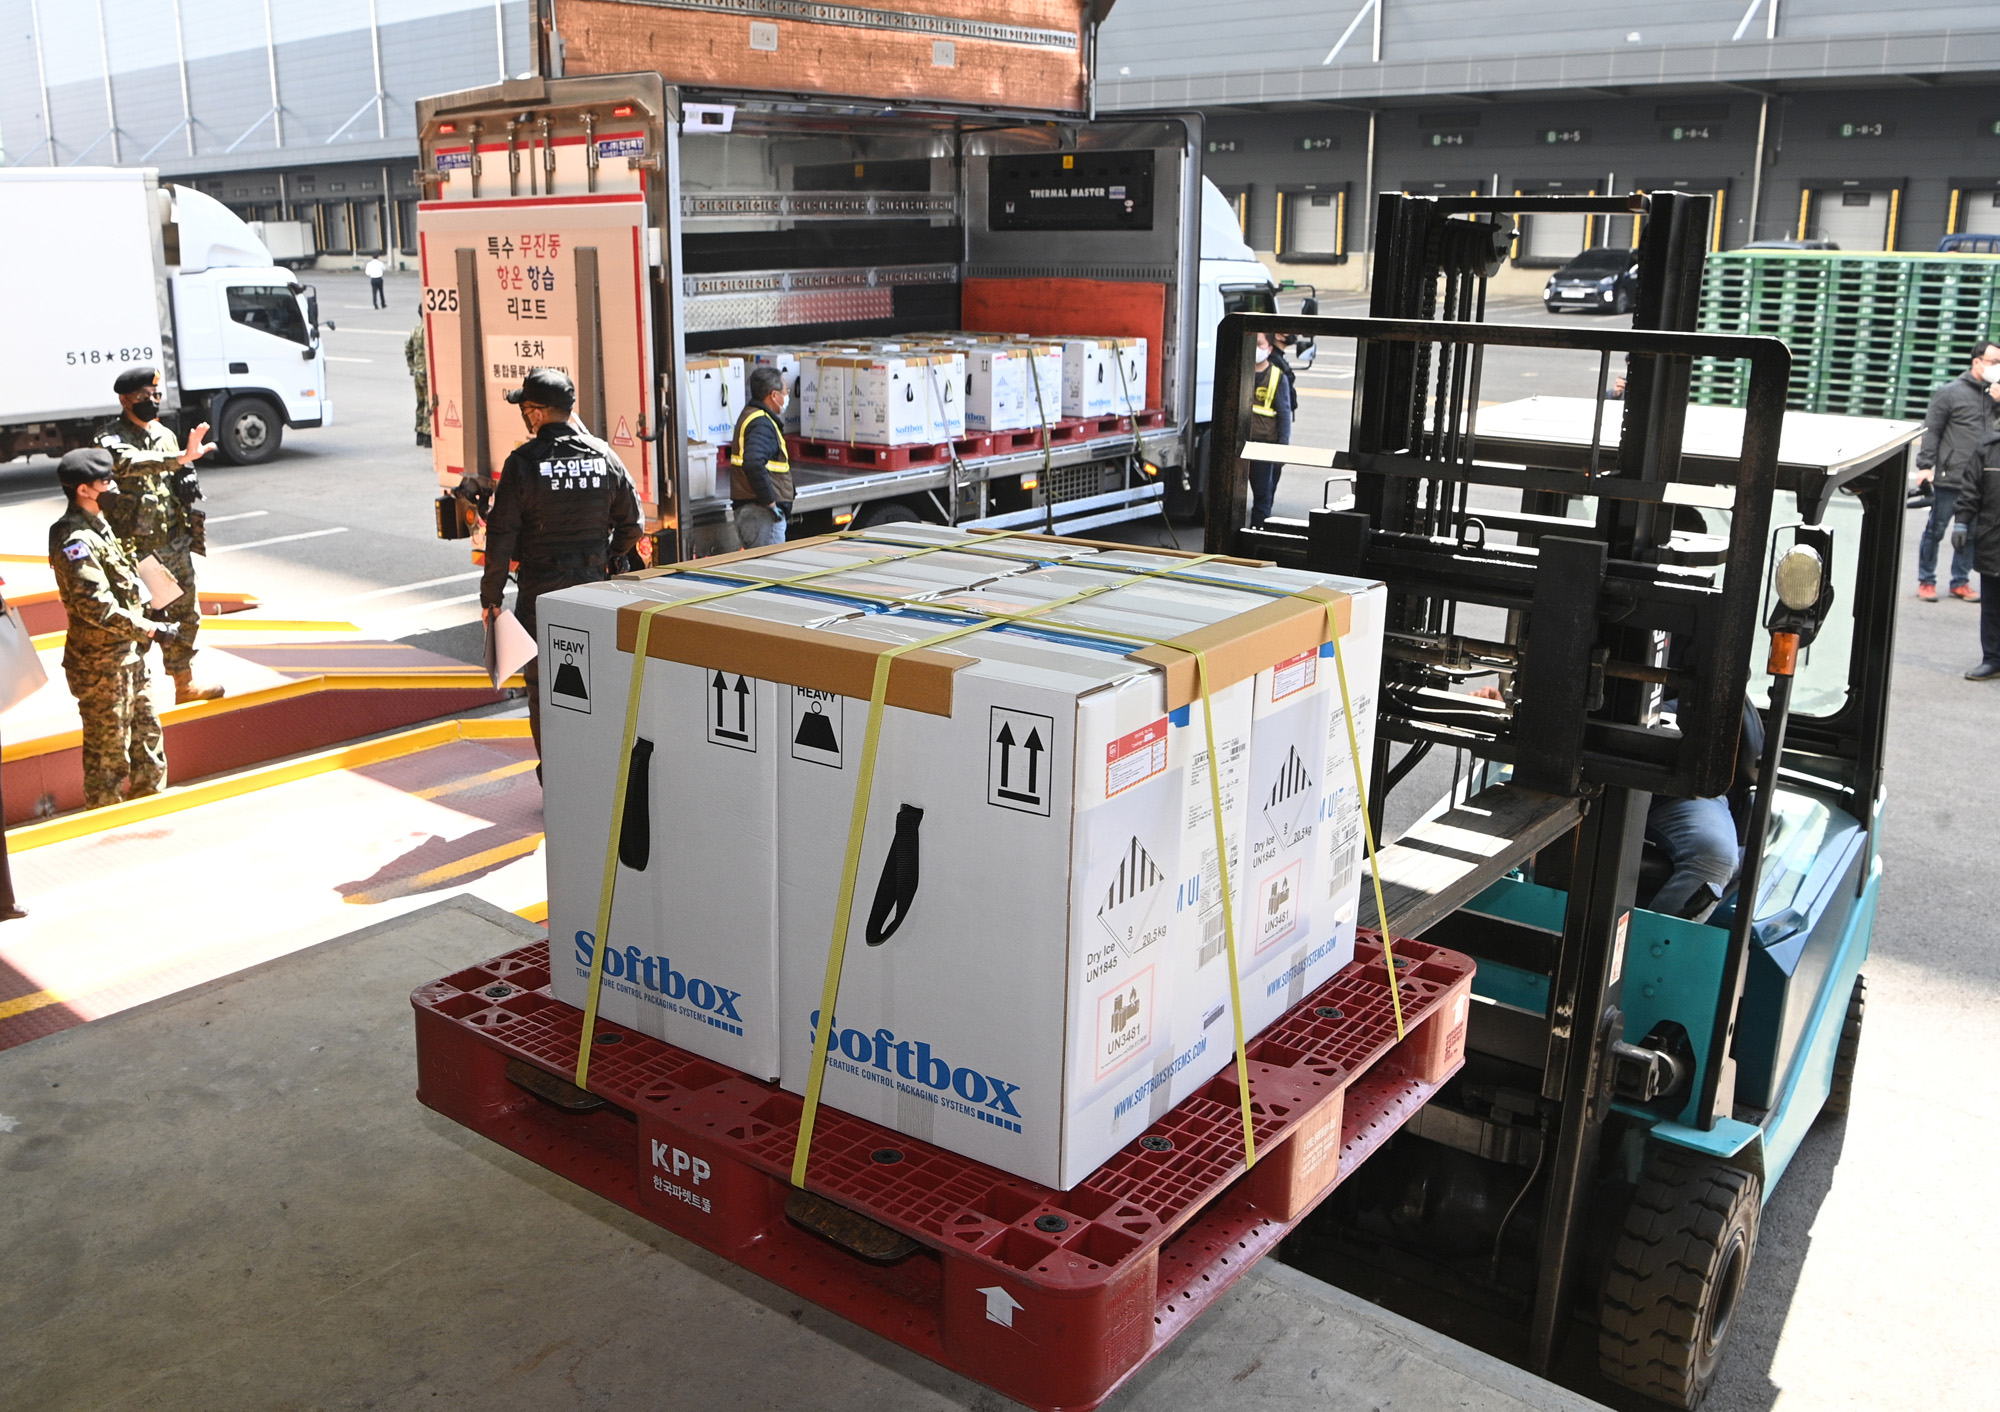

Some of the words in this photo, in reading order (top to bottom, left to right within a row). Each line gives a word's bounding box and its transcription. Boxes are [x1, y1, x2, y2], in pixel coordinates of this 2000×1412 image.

[1030, 188, 1068, 198] THERMAL
[1070, 187, 1105, 197] MASTER
[488, 236, 514, 260] 특수
[519, 232, 561, 259] 무진동
[496, 265, 523, 291] 항온
[527, 265, 555, 292] 항습
[426, 288, 459, 312] 325
[507, 296, 547, 321] 리프트
[514, 340, 545, 360] 1호차
[895, 424, 923, 434] Softbox
[553, 638, 585, 655] HEAVY
[1254, 840, 1265, 853] Dry
[1266, 835, 1275, 847] Ice
[1252, 847, 1276, 868] UN1845
[1127, 925, 1133, 937] 9
[1264, 909, 1290, 933] UN3481
[1087, 949, 1101, 966] Dry
[1103, 942, 1116, 956] Ice
[574, 930, 743, 1023] Softbox
[1086, 955, 1118, 983] UN1845
[616, 982, 643, 1000] CONTROL
[644, 992, 678, 1012] PACKAGING
[679, 1005, 707, 1023] SYSTEMS
[1107, 1023, 1141, 1055] UN3481
[810, 1009, 1022, 1119] Softbox
[1113, 1036, 1207, 1121] WWW.SOFTBOXSYSTEMS.COM
[861, 1069, 894, 1089] CONTROL
[896, 1081, 939, 1104] PACKAGING
[940, 1096, 976, 1117] SYSTEMS
[651, 1138, 711, 1186] KPP
[652, 1174, 712, 1214] 한국파렛트풀
